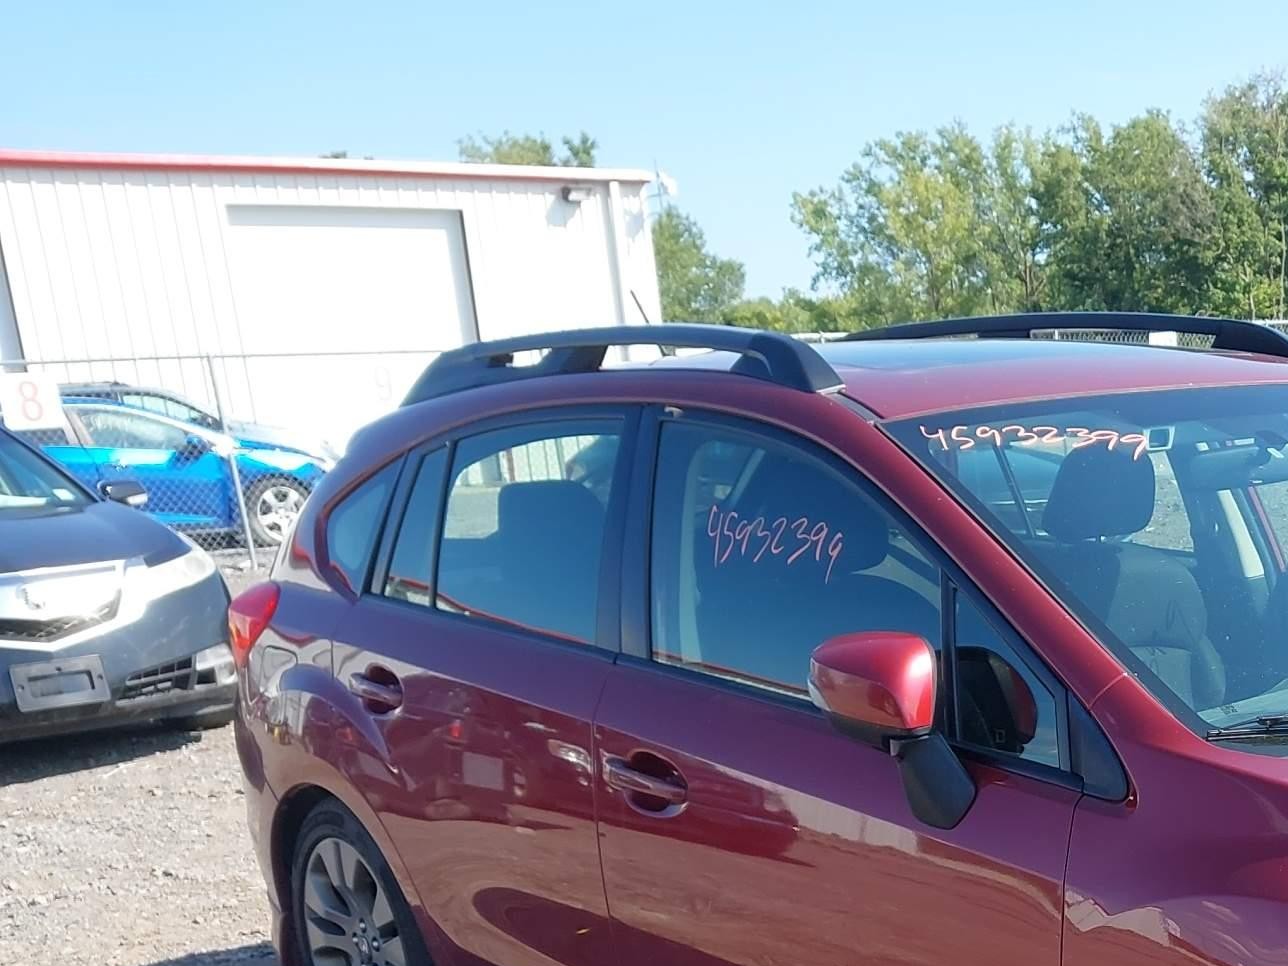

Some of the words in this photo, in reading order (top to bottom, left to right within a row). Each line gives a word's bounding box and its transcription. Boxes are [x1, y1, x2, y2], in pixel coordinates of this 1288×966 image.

[18, 380, 44, 422] 8
[919, 424, 1149, 461] 45932399
[706, 504, 844, 585] 45932399
